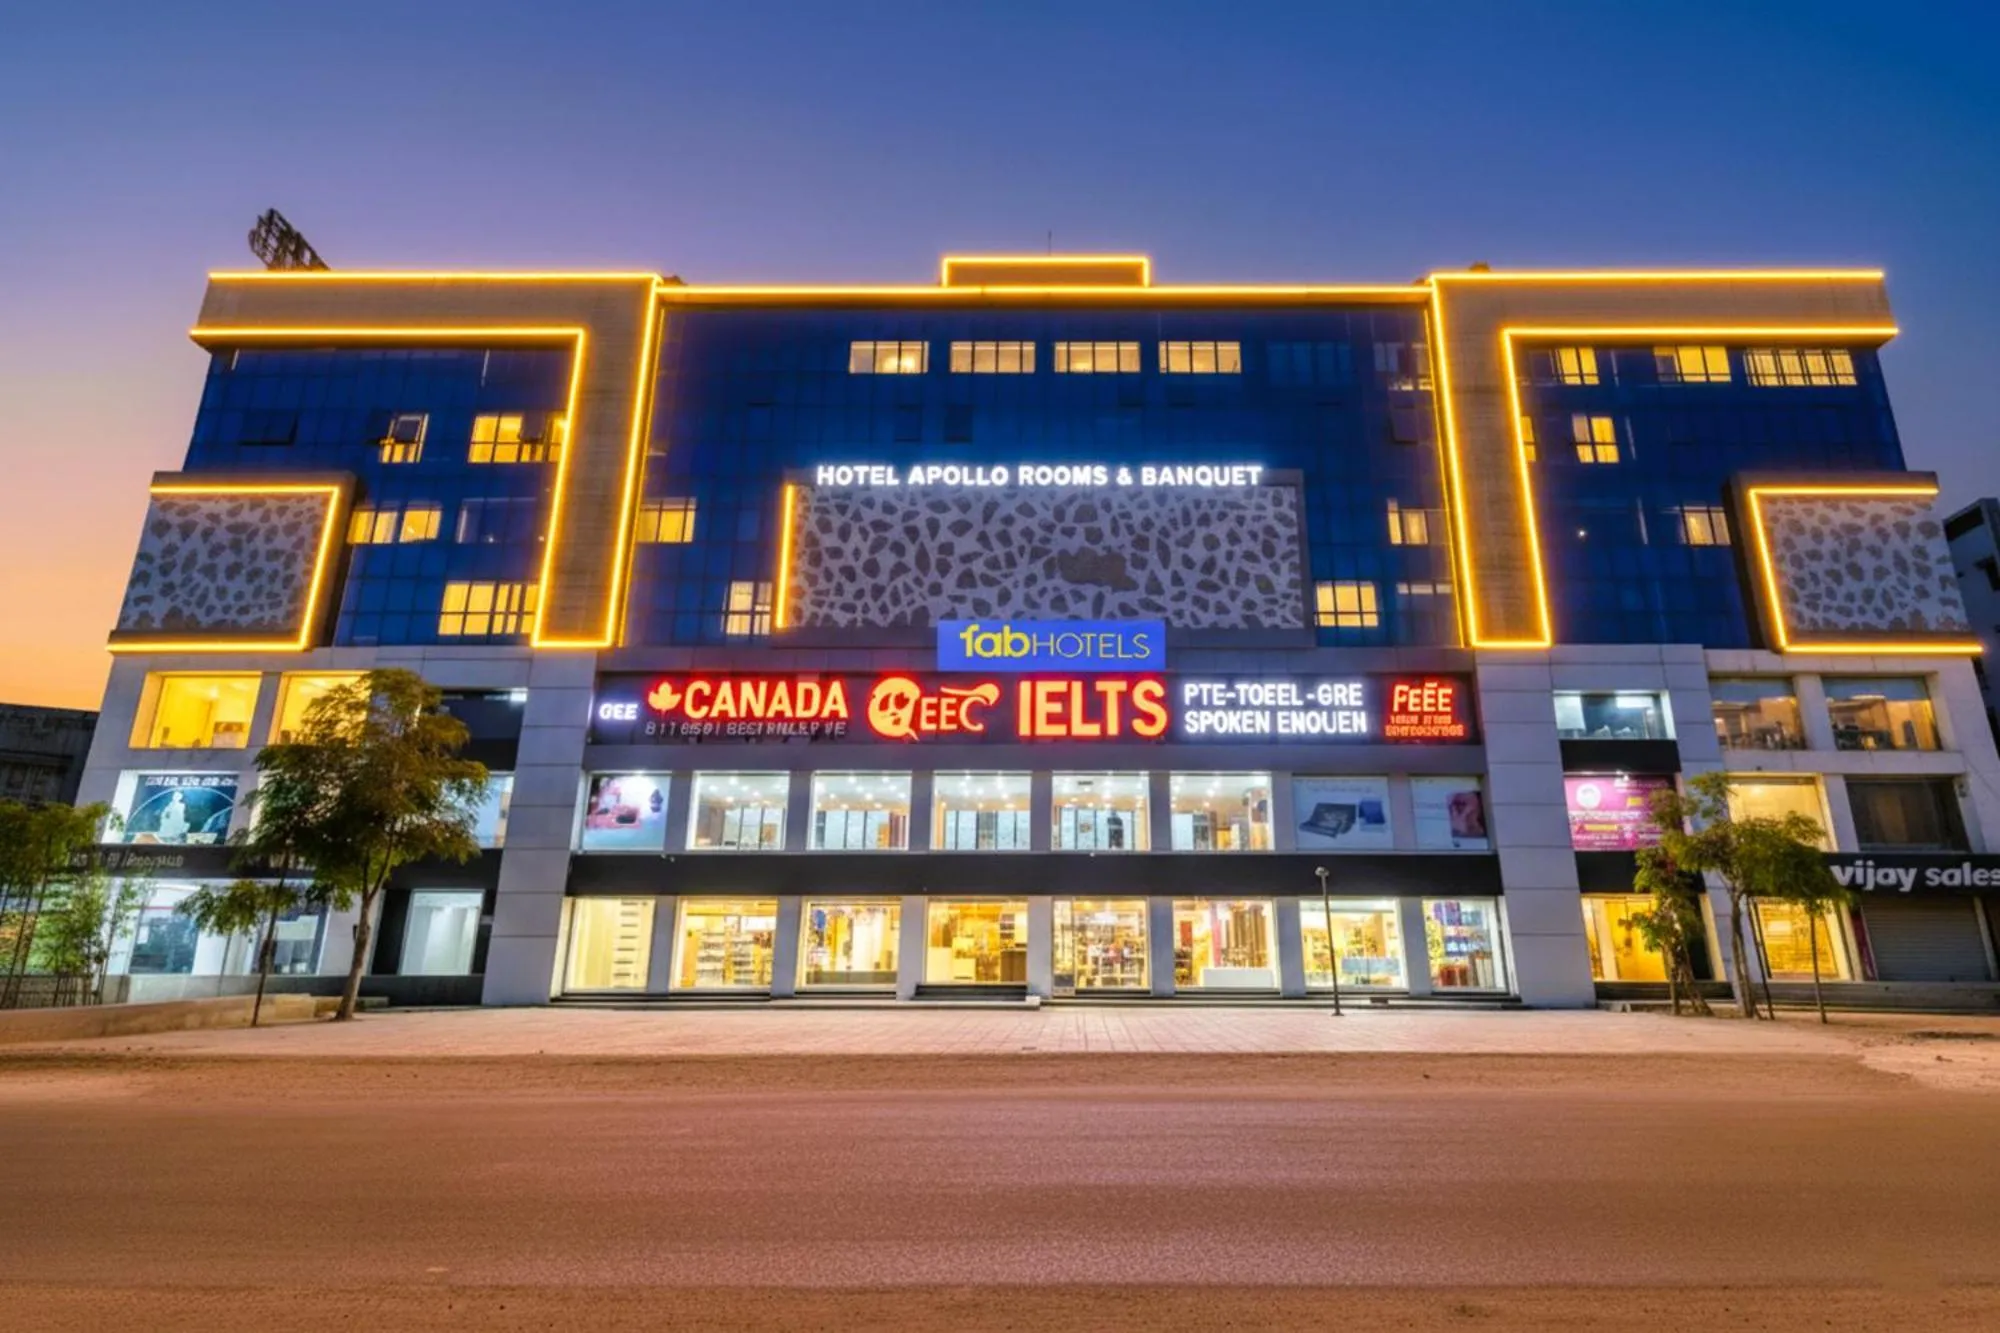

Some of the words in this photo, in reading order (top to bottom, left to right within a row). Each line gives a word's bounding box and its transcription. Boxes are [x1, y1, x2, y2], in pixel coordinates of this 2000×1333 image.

[817, 465, 899, 486] HOTEL
[908, 465, 1009, 486] APOLLO
[1018, 465, 1108, 486] ROOMS
[1116, 466, 1133, 486] &
[1141, 465, 1263, 487] BANQUET
[684, 680, 848, 719] CANADA
[1018, 680, 1168, 737] IELTS
[1184, 710, 1271, 734] SPOKEN
[1830, 860, 1918, 892] vijay
